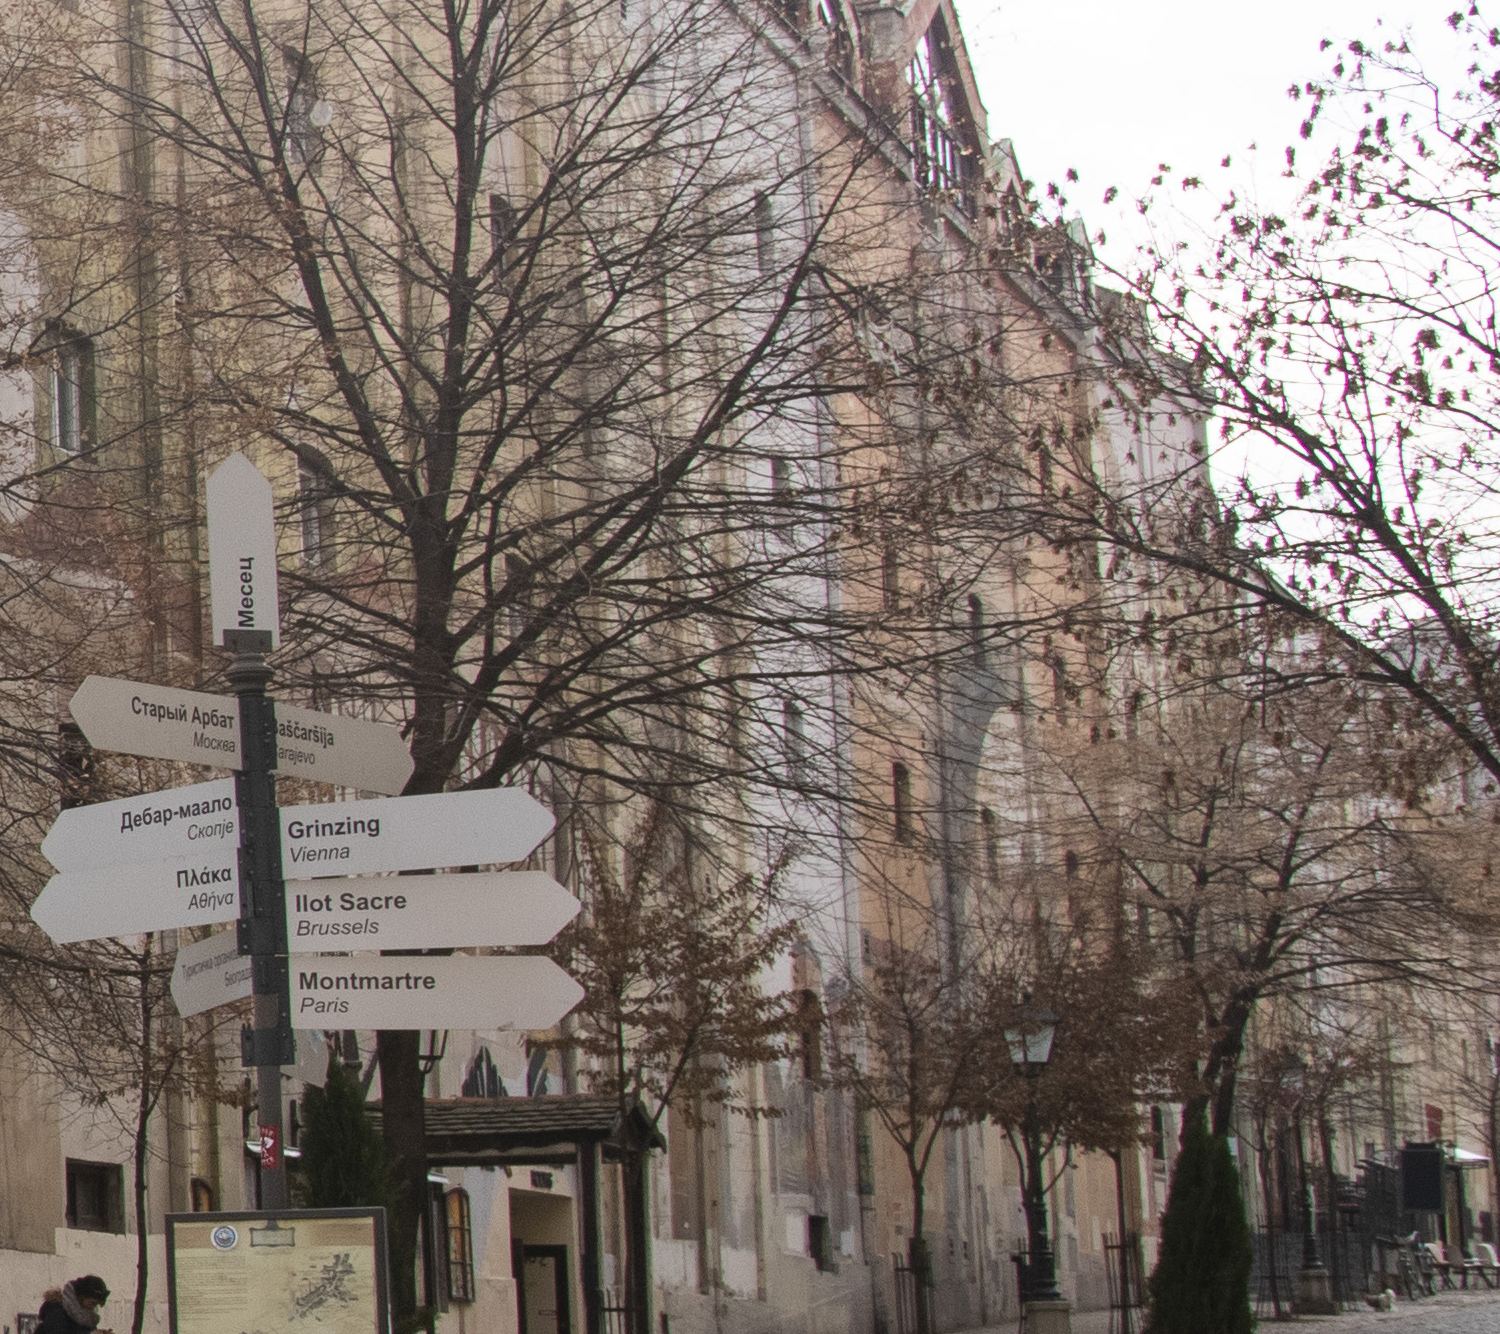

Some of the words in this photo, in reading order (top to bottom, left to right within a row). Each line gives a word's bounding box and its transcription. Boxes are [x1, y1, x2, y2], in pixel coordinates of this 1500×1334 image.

[237, 556, 255, 628] Месец
[131, 695, 188, 723] Старый
[191, 702, 235, 732] Арбат
[192, 732, 237, 754] Москва
[277, 743, 316, 766] arajevo
[120, 794, 233, 833] Дебар-маало
[187, 819, 235, 844] Скопје
[287, 816, 381, 841] Grinzing
[289, 843, 350, 864] Vienna
[176, 865, 233, 889] Πλάκα
[188, 889, 235, 912] Αθήνα
[296, 893, 333, 913] Ilot
[339, 892, 407, 912] Sacre
[296, 917, 380, 937] Brussels
[299, 972, 436, 992] Montmartre
[300, 996, 349, 1014] Paris
